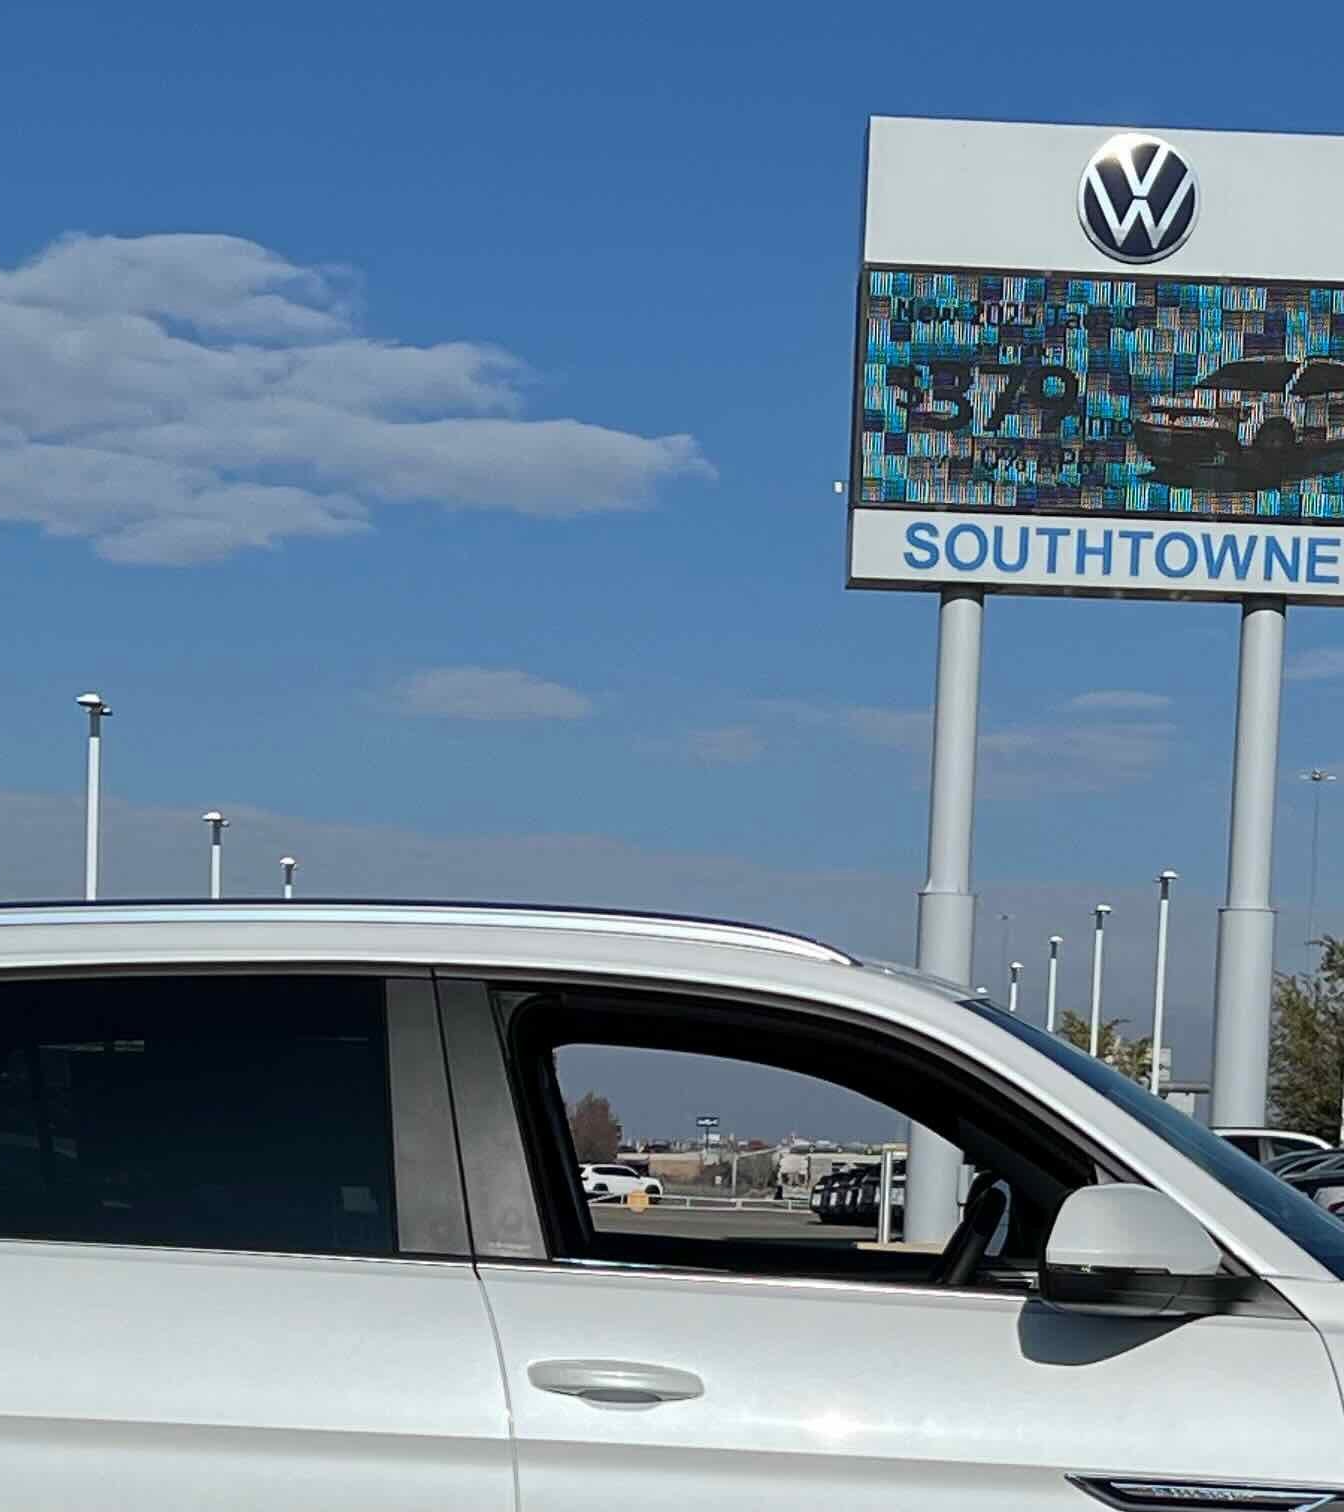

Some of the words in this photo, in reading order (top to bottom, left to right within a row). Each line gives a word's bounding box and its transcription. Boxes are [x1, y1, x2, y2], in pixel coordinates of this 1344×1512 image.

[971, 302, 1037, 327] 2025
[887, 362, 1079, 432] $379
[1038, 447, 1095, 471] APR
[903, 521, 1342, 585] SOUTHTOWNE
